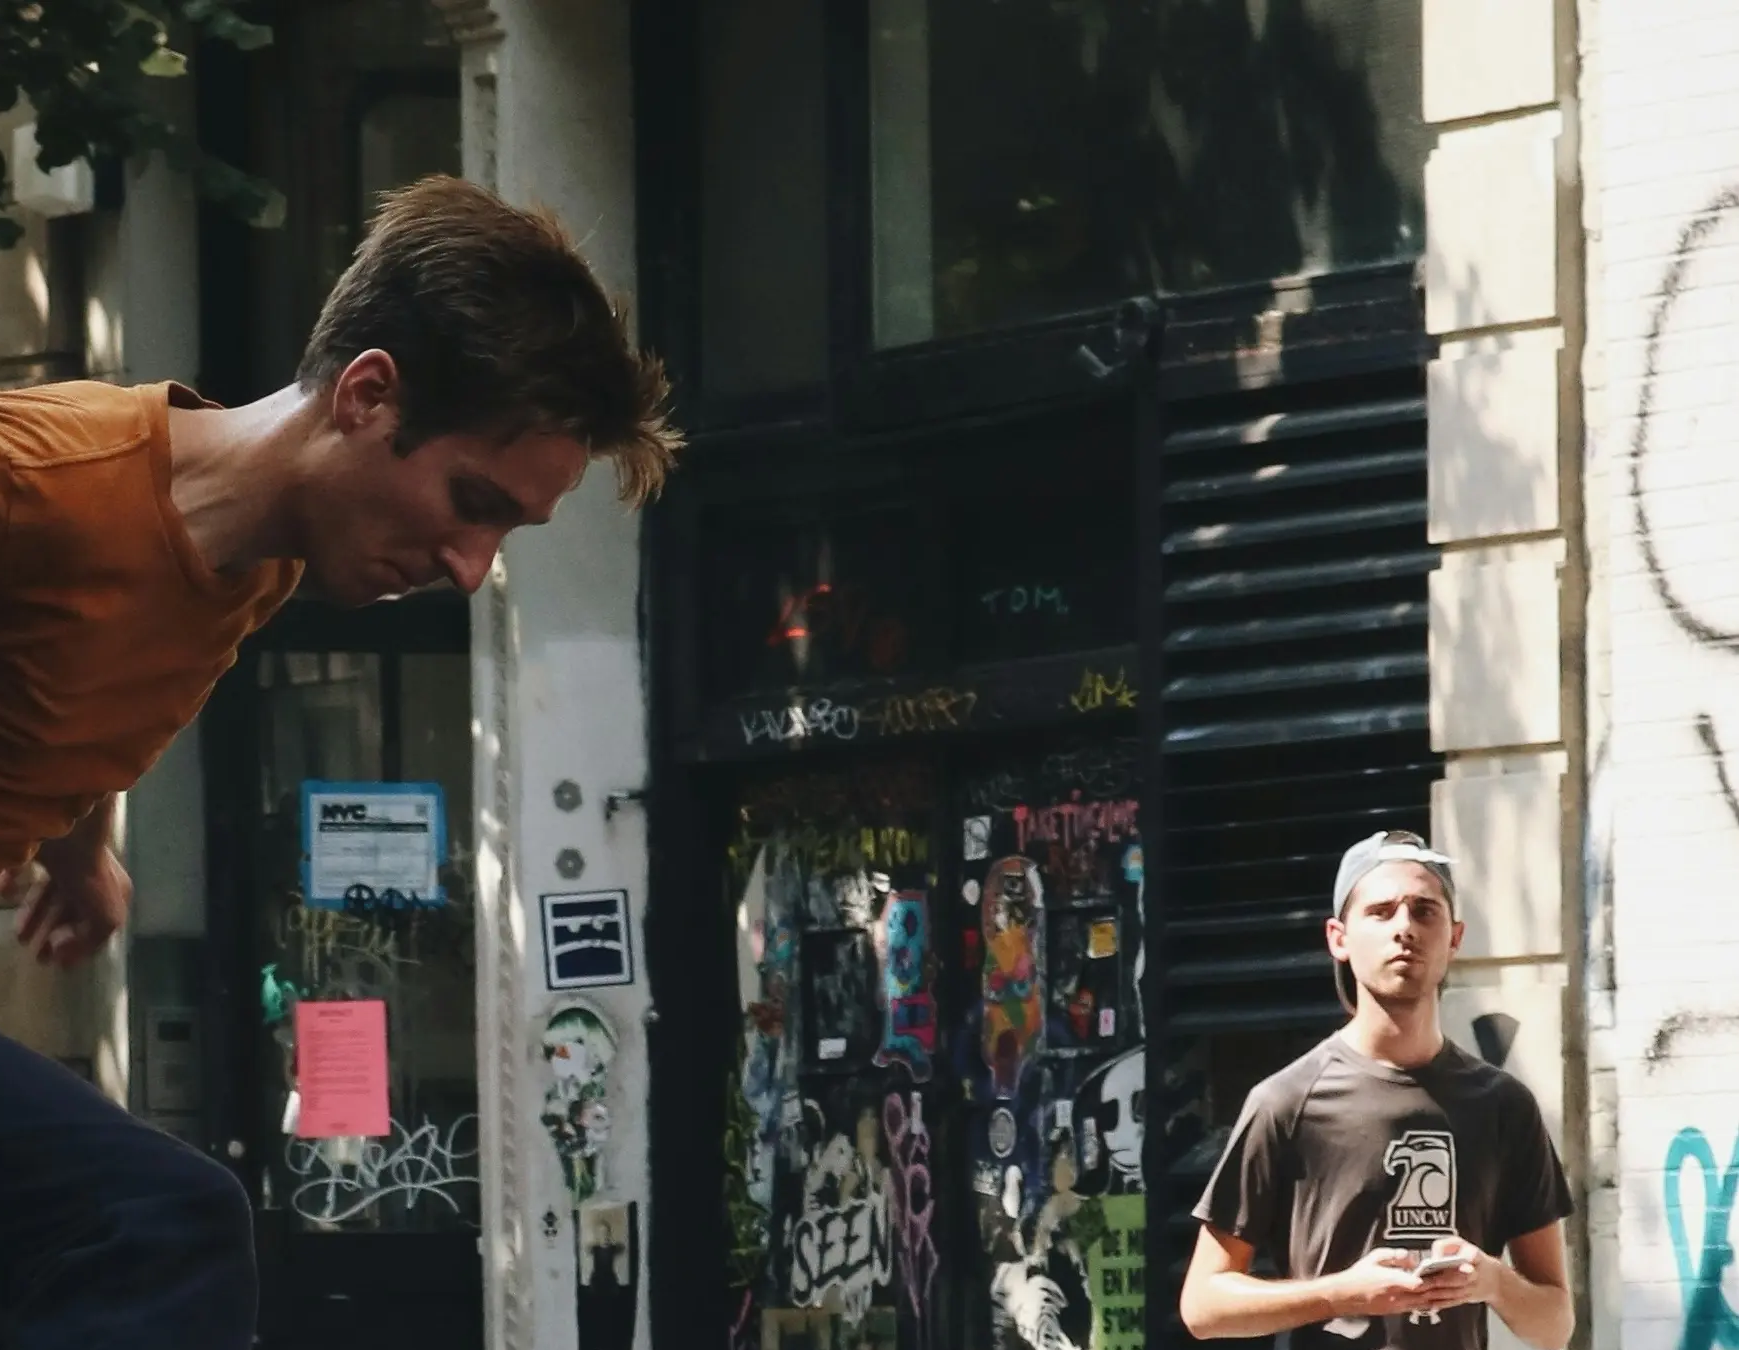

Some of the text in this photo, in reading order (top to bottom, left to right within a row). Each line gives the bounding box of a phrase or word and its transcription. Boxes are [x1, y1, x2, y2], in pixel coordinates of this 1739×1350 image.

[321, 804, 366, 819] NYC
[1394, 1210, 1449, 1226] UNCW
[791, 1197, 893, 1306] SEEN
